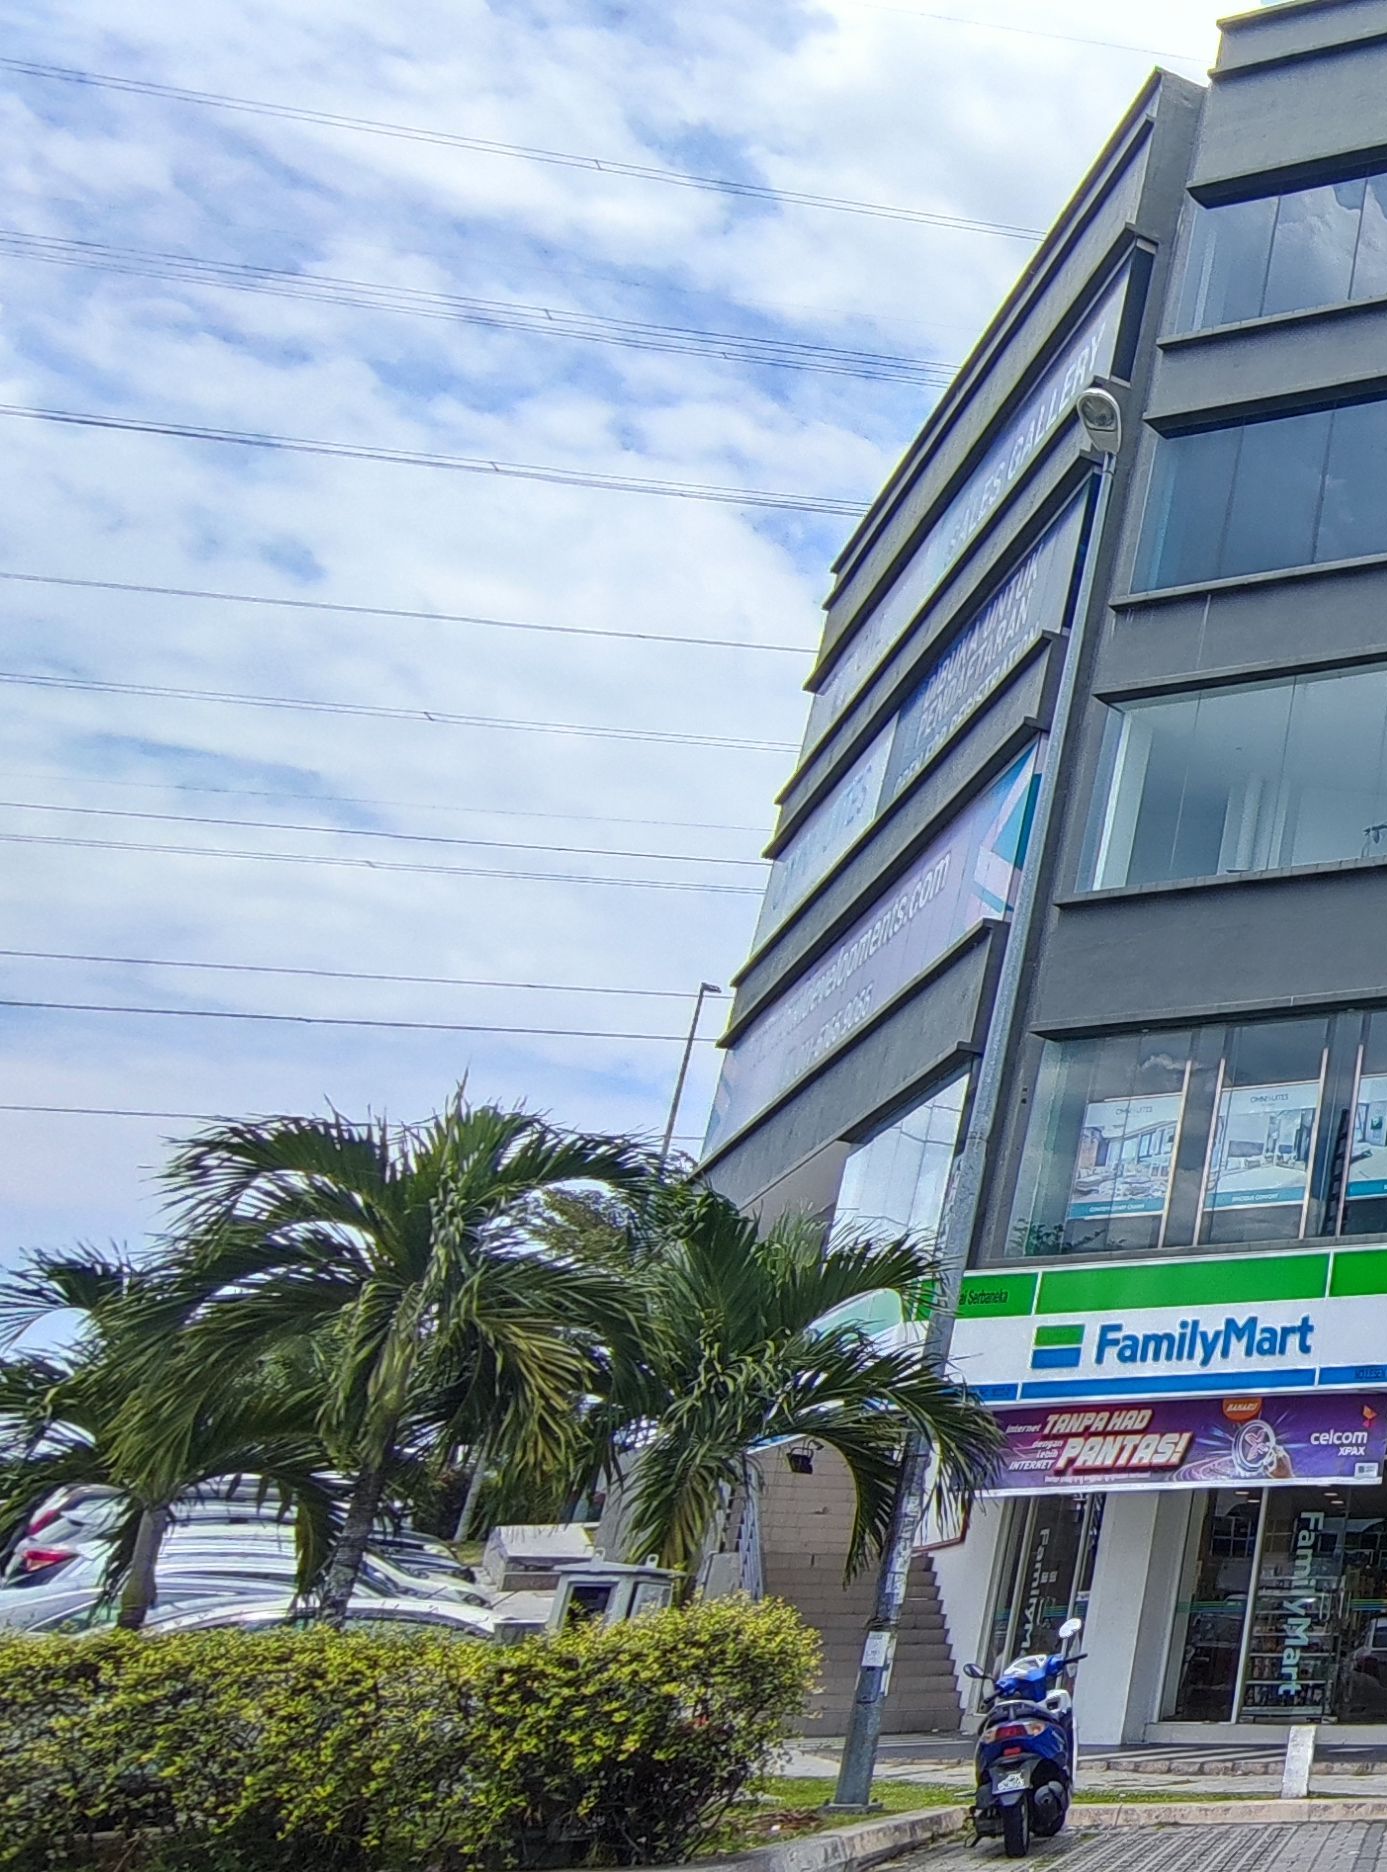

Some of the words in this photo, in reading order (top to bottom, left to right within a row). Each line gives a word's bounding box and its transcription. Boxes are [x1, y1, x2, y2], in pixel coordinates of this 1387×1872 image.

[1007, 321, 1106, 480] GALLERY
[983, 542, 1044, 639] UNTUK
[915, 587, 1033, 749] PENDAFTARAN
[968, 1288, 1008, 1305] Serbaneka
[1095, 1315, 1314, 1366] FamilyMart
[1043, 1411, 1106, 1435] TANPA
[1108, 1408, 1152, 1431] HAD
[1310, 1429, 1368, 1445] celcom
[1008, 1459, 1056, 1471] INTERNET
[1055, 1432, 1192, 1471] PANTAS!
[1337, 1446, 1365, 1456] XPAX
[1278, 1512, 1324, 1695] FamilyMart
